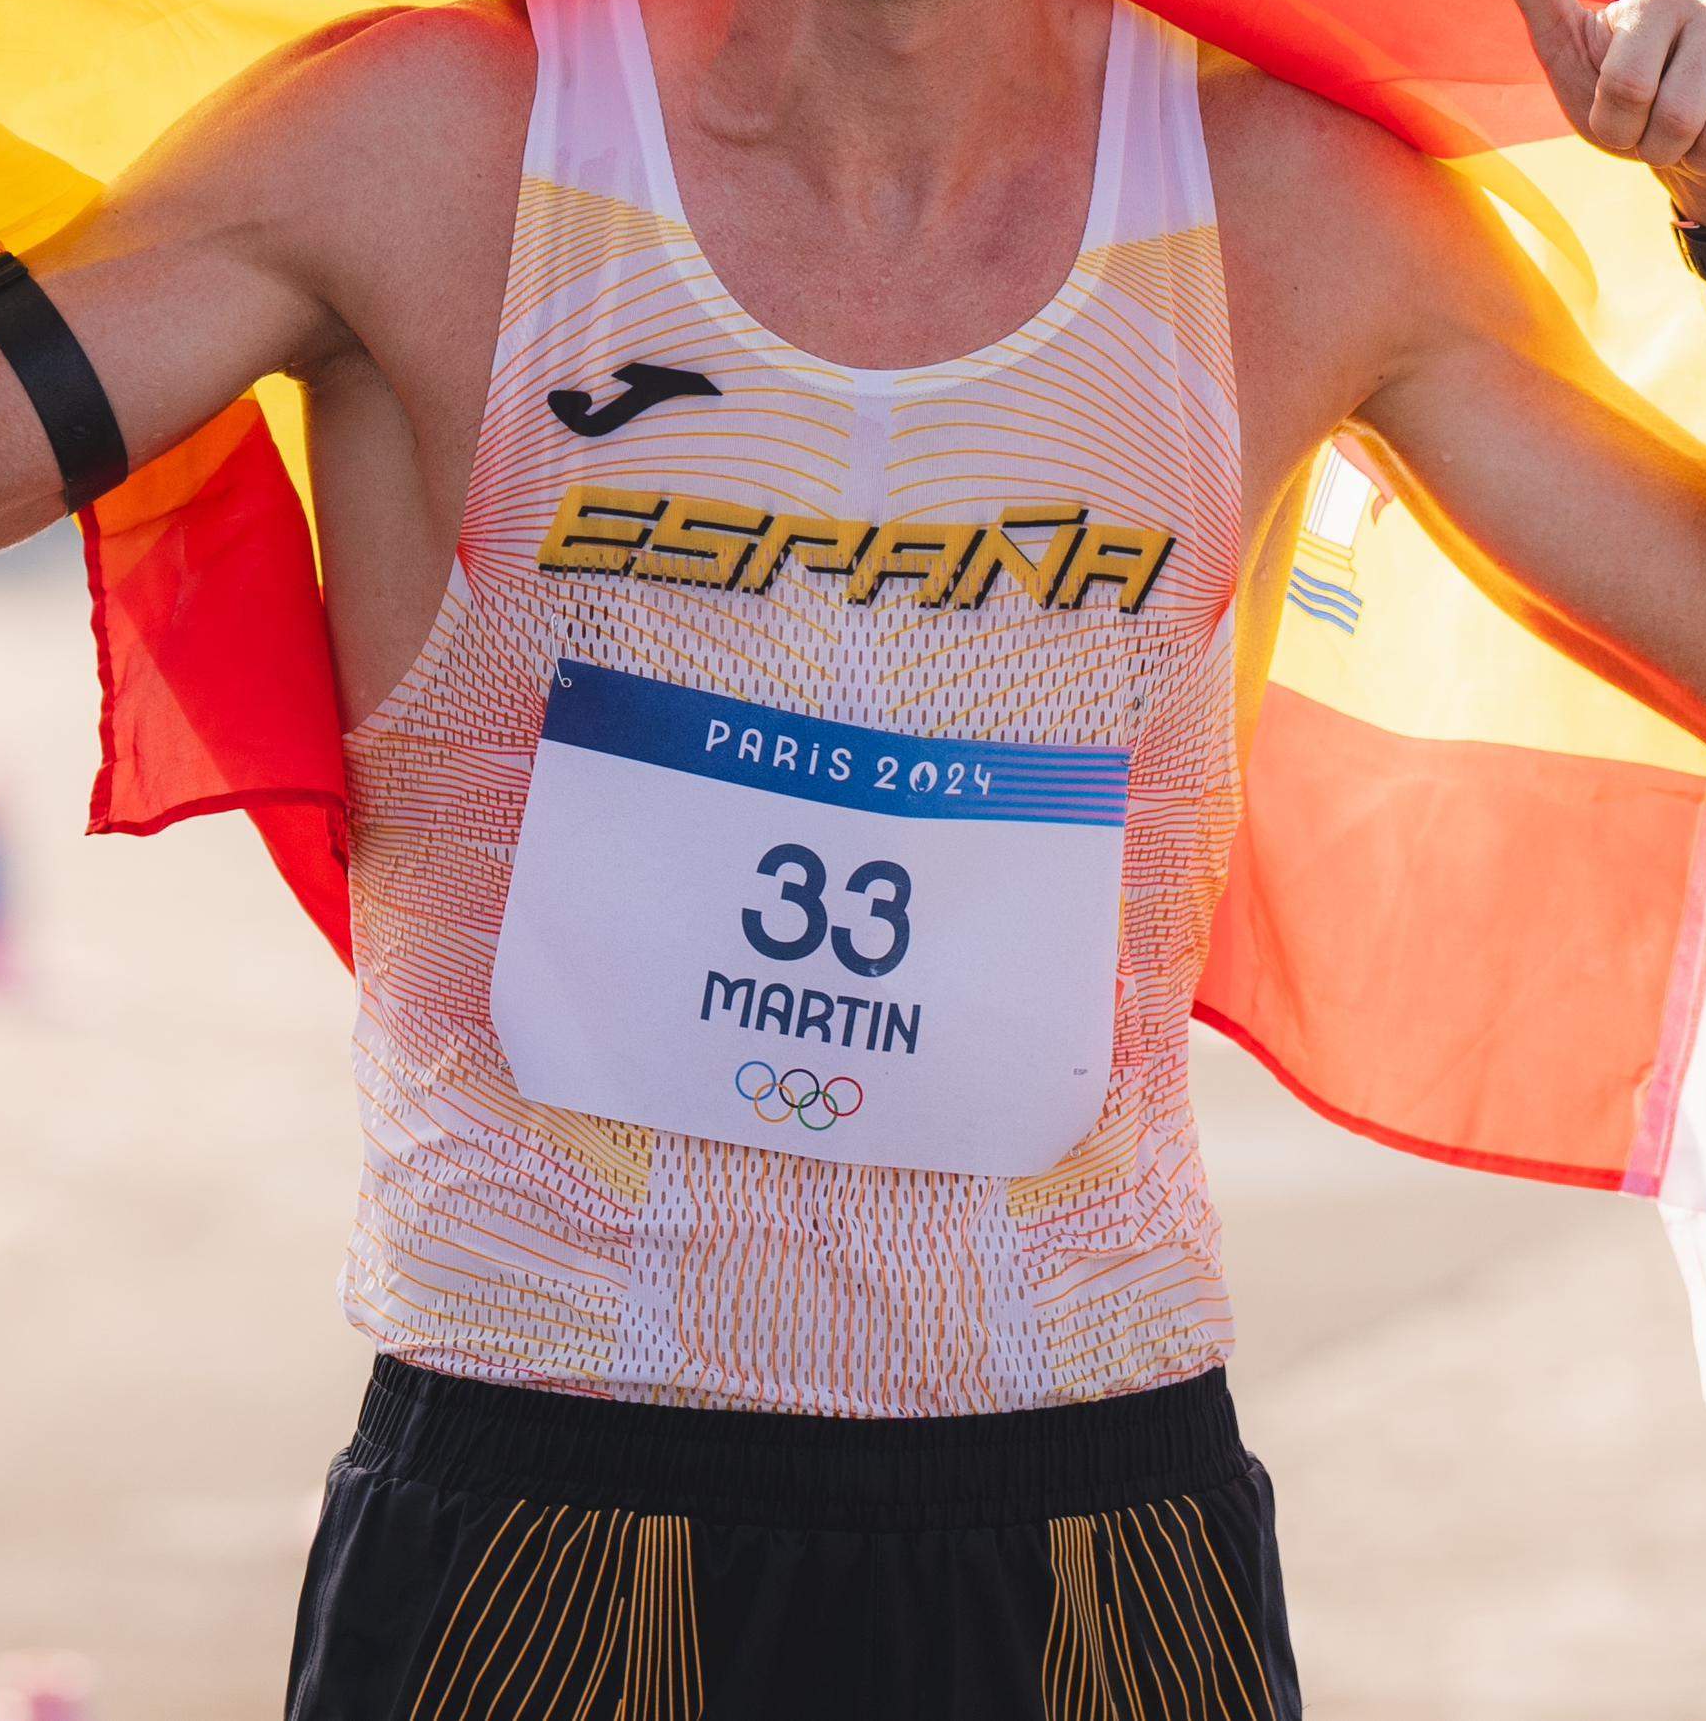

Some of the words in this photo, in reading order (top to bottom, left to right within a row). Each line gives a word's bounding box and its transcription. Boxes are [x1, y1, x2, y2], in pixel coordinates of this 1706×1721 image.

[535, 485, 1177, 615] ESPAÑA
[873, 755, 992, 796] 2024
[741, 843, 912, 978] 33
[700, 970, 922, 1055] MARTIN
